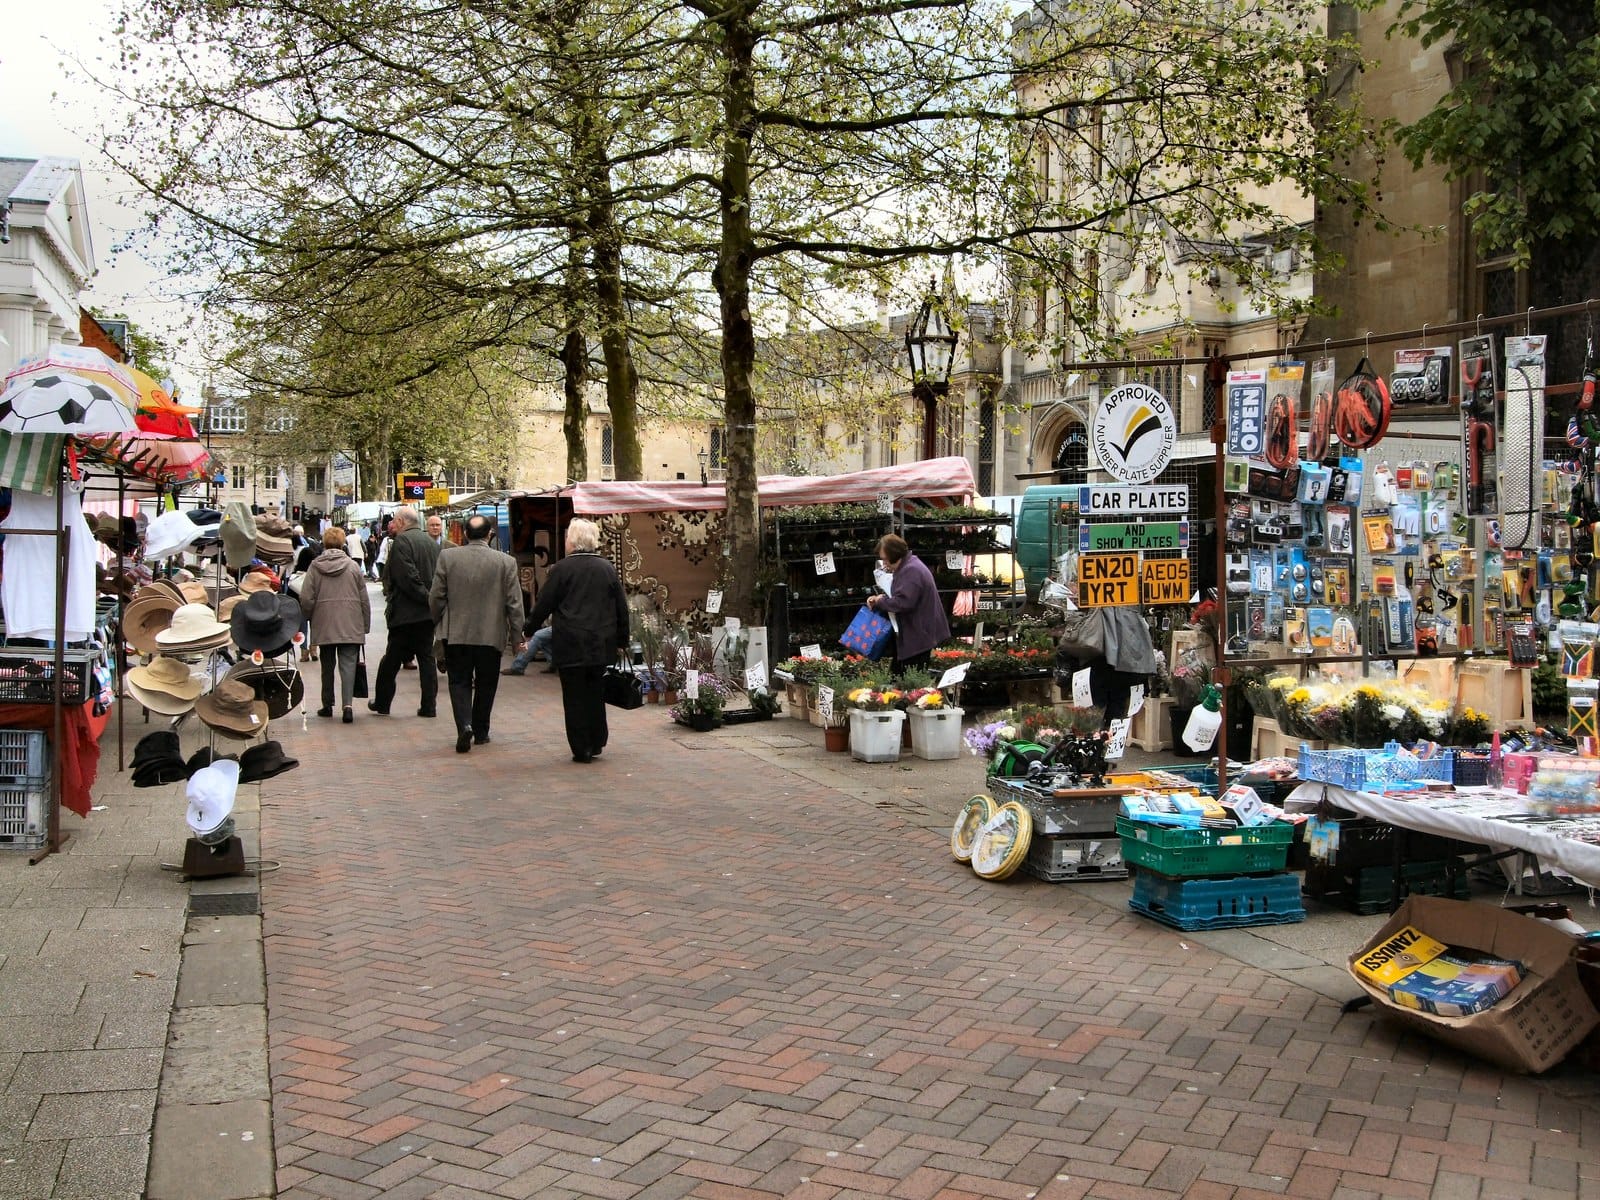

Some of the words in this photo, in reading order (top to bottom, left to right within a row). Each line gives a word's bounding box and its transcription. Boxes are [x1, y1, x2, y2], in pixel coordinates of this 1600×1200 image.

[1105, 387, 1165, 414] APPROVED
[1240, 389, 1260, 451] OPEN
[1097, 424, 1118, 473] NUMBER
[1119, 468, 1149, 480] PLATE
[1150, 425, 1173, 474] SUPPLIER
[413, 486, 423, 495] &
[1092, 493, 1121, 508] CAR
[1129, 491, 1186, 508] PLATES
[1125, 524, 1145, 536] AND
[1096, 537, 1123, 549] SHOW
[1132, 536, 1172, 548] PLATES
[1090, 582, 1128, 603] YRT
[1150, 582, 1183, 600] UWM
[1360, 929, 1421, 971] ZANUSSI
